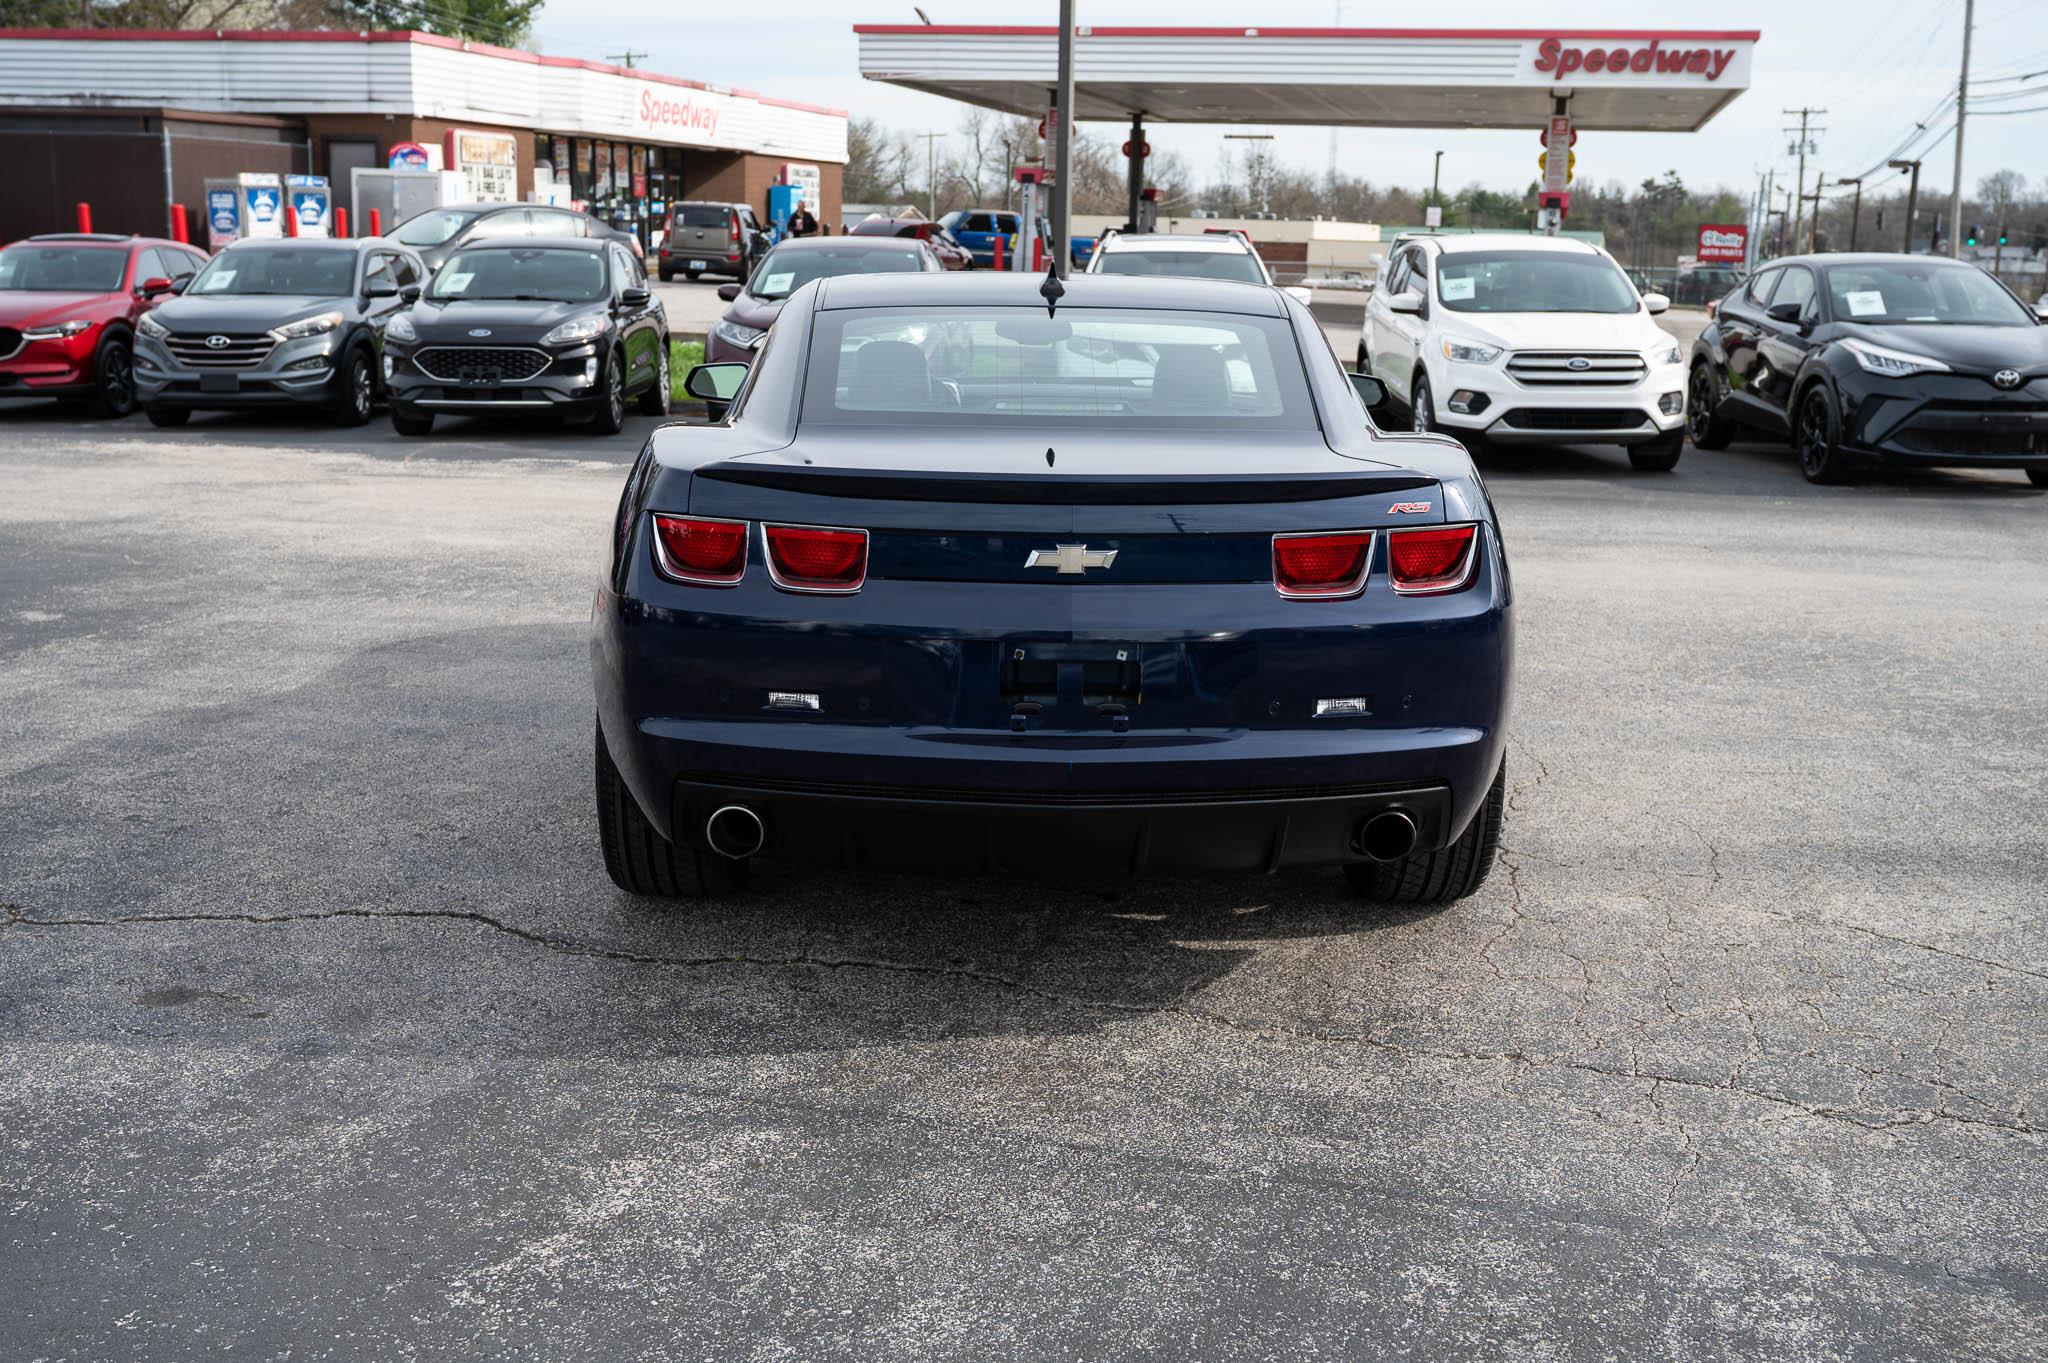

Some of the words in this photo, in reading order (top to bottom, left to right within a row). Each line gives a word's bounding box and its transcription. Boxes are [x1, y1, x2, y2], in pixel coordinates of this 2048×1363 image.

[1534, 38, 1736, 81] Speedway
[640, 88, 720, 137] Speedway
[1701, 248, 1719, 256] AUTO
[1720, 249, 1743, 257] PARTS
[1387, 501, 1432, 514] RS
